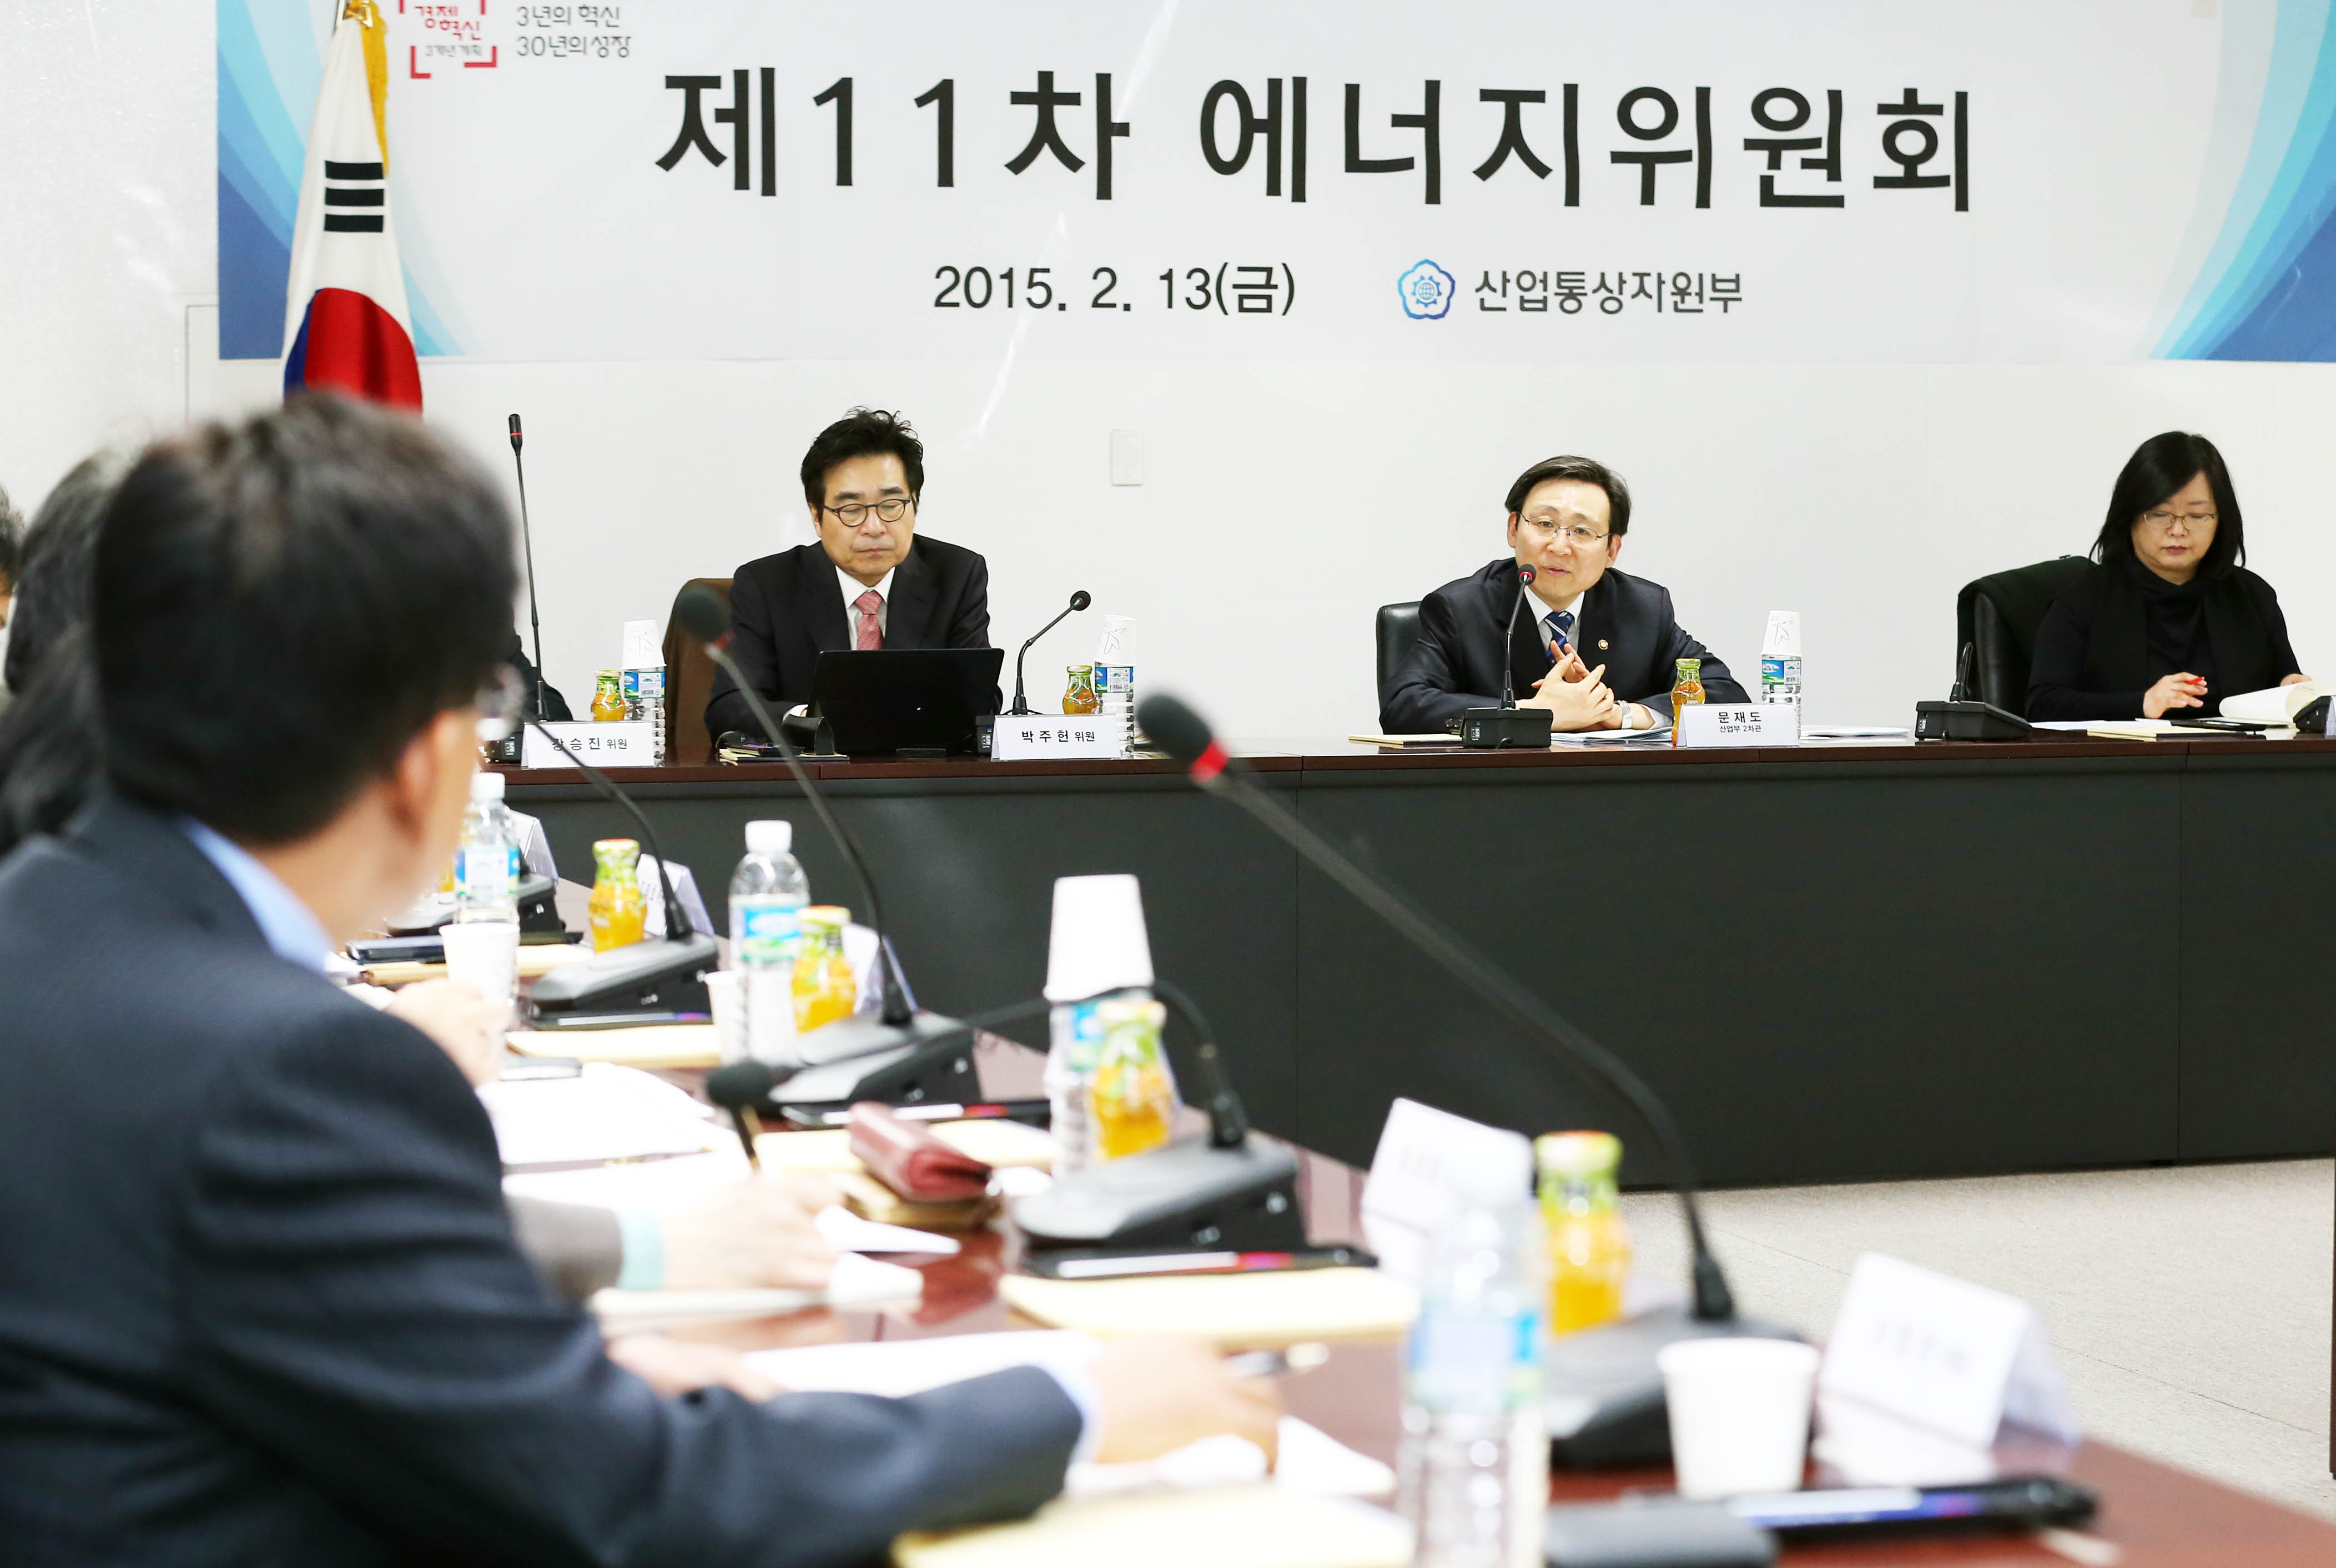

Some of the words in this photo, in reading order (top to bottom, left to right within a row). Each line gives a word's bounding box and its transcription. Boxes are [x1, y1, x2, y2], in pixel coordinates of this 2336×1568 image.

[517, 6, 571, 28] 3년의
[578, 4, 620, 28] 혁신
[439, 19, 482, 41] 혁신
[655, 67, 1130, 200] 제11차
[1200, 76, 1969, 213] 에너지위원회
[934, 265, 1066, 311] 2015.
[1091, 266, 1131, 312] 2.
[1159, 261, 1295, 316] 13(금)
[1474, 270, 1743, 315] 산업통상자원부
[606, 739, 627, 749] 위원
[1075, 731, 1095, 742] 위원
